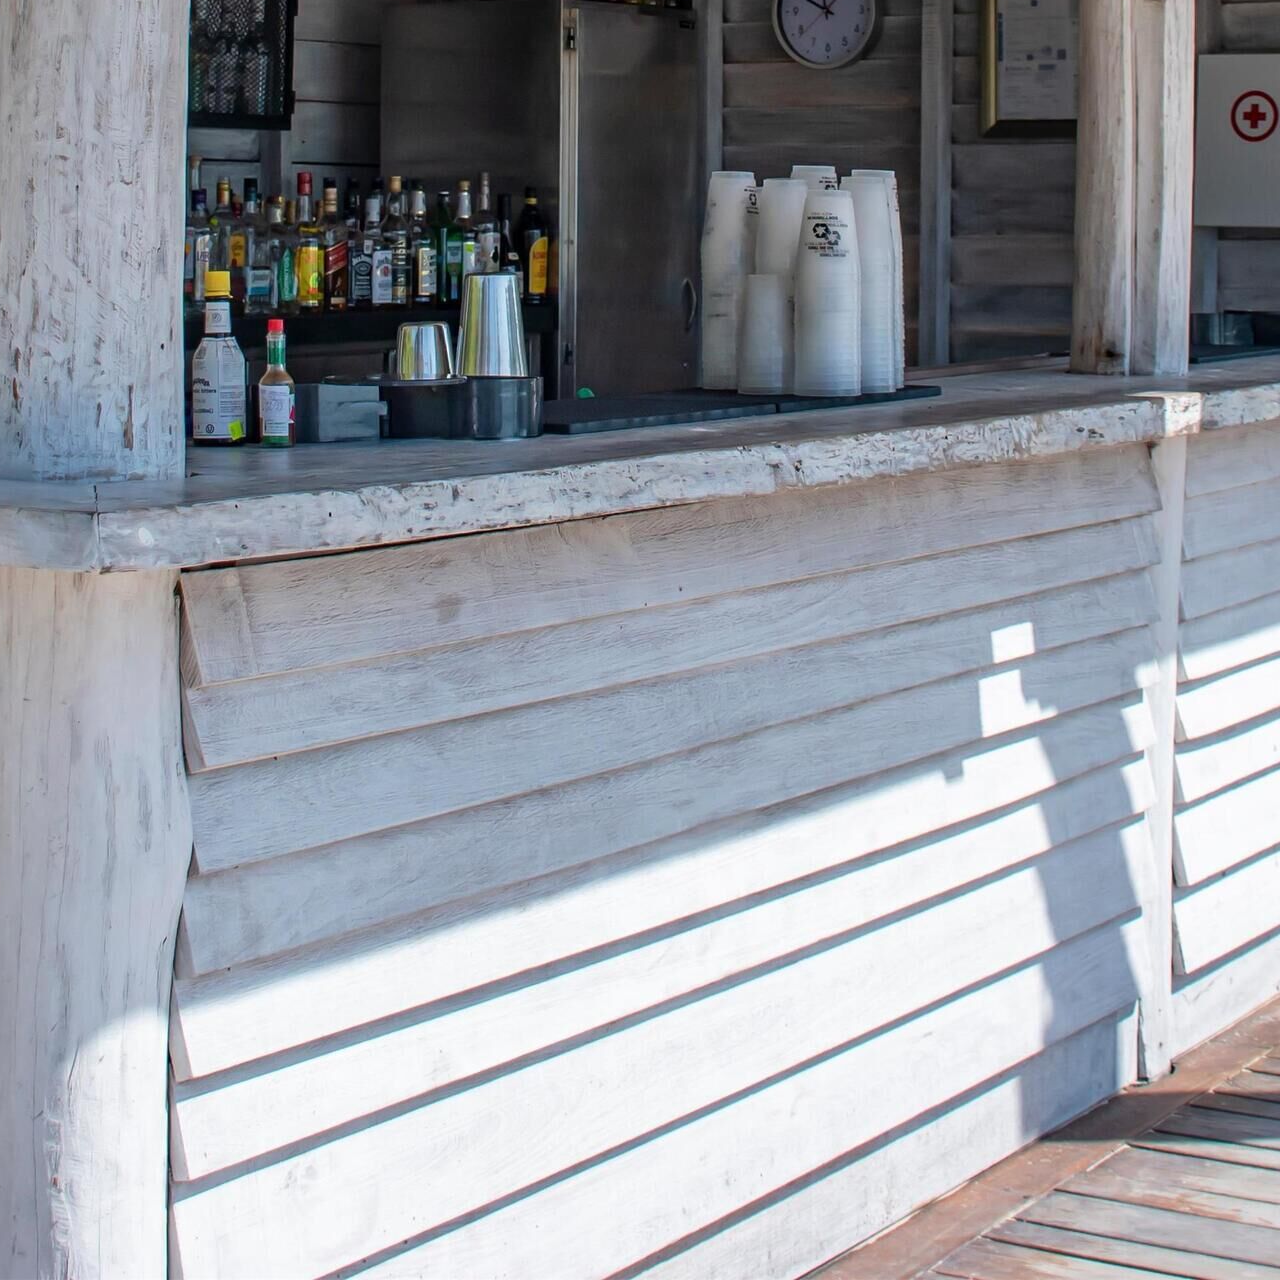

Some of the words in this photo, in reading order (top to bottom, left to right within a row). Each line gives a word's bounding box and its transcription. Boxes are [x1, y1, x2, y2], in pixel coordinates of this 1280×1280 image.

[792, 6, 799, 16] 9
[858, 4, 865, 15] 3
[853, 23, 860, 33] 4
[811, 37, 817, 47] 7
[841, 36, 848, 47] 5
[824, 42, 831, 53] 6
